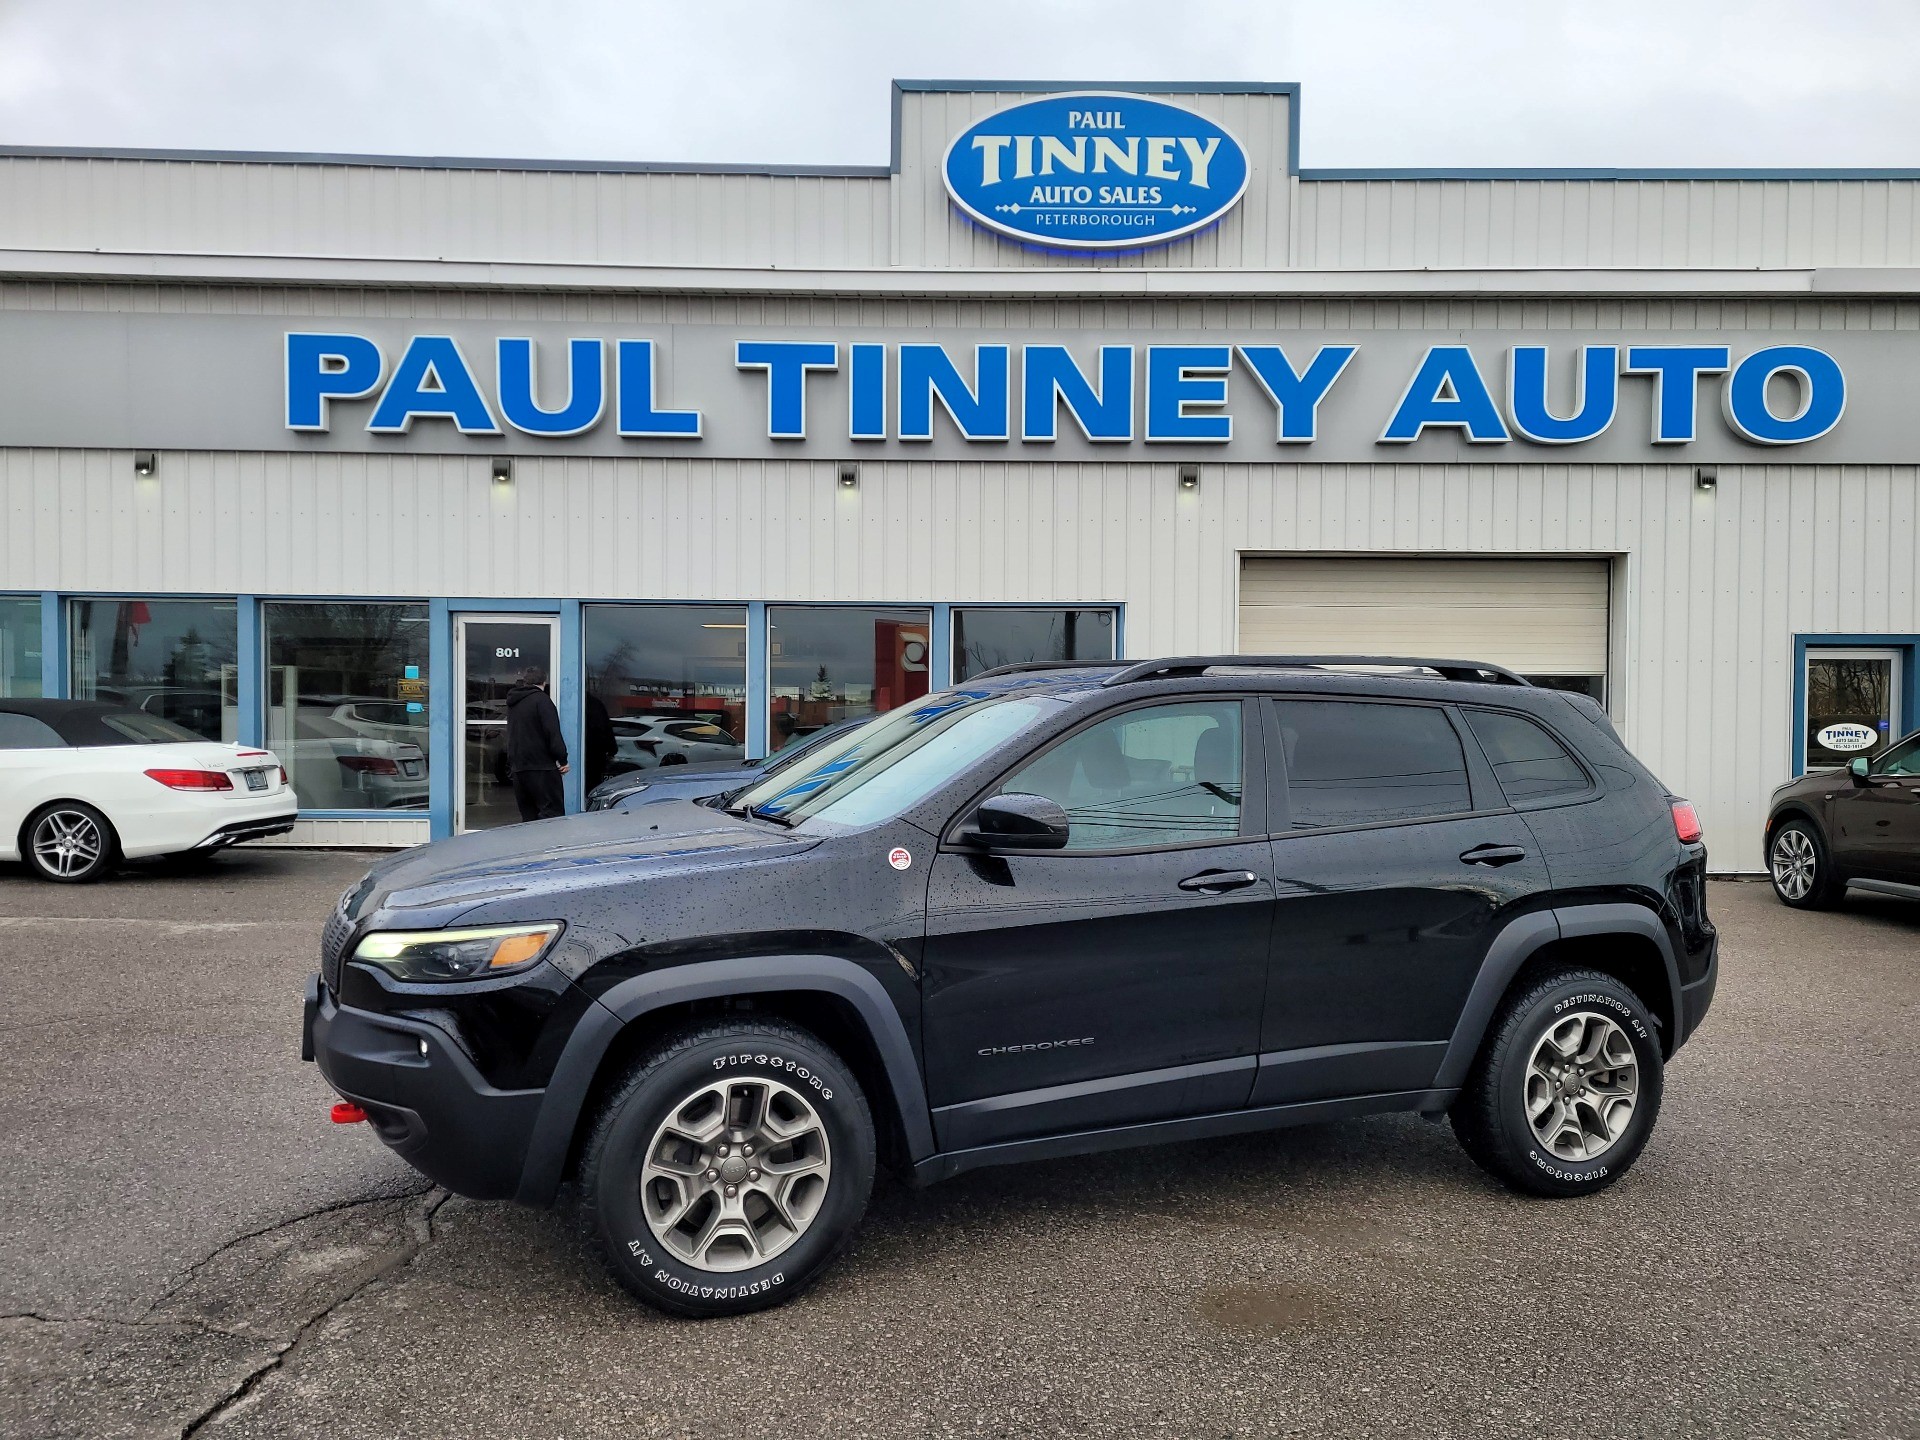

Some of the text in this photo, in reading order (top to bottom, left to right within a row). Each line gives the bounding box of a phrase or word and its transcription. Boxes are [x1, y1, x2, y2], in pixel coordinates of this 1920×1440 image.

[1068, 111, 1126, 129] PAUL
[971, 135, 1222, 190] TINNEY
[1029, 186, 1163, 205] AUTO SALES
[1036, 213, 1156, 226] PETERBOROUGH
[284, 331, 1848, 447] PAUL TINNEY AUTO
[495, 647, 520, 658] 801
[1825, 730, 1869, 740] TINNEY
[1553, 994, 1648, 1040] DESTINATION A/T
[977, 1037, 1095, 1056] CHEROKEE
[713, 1054, 833, 1100] Firestone
[1529, 1150, 1608, 1182] Firestone
[628, 1239, 785, 1299] DESTINATION A/T
